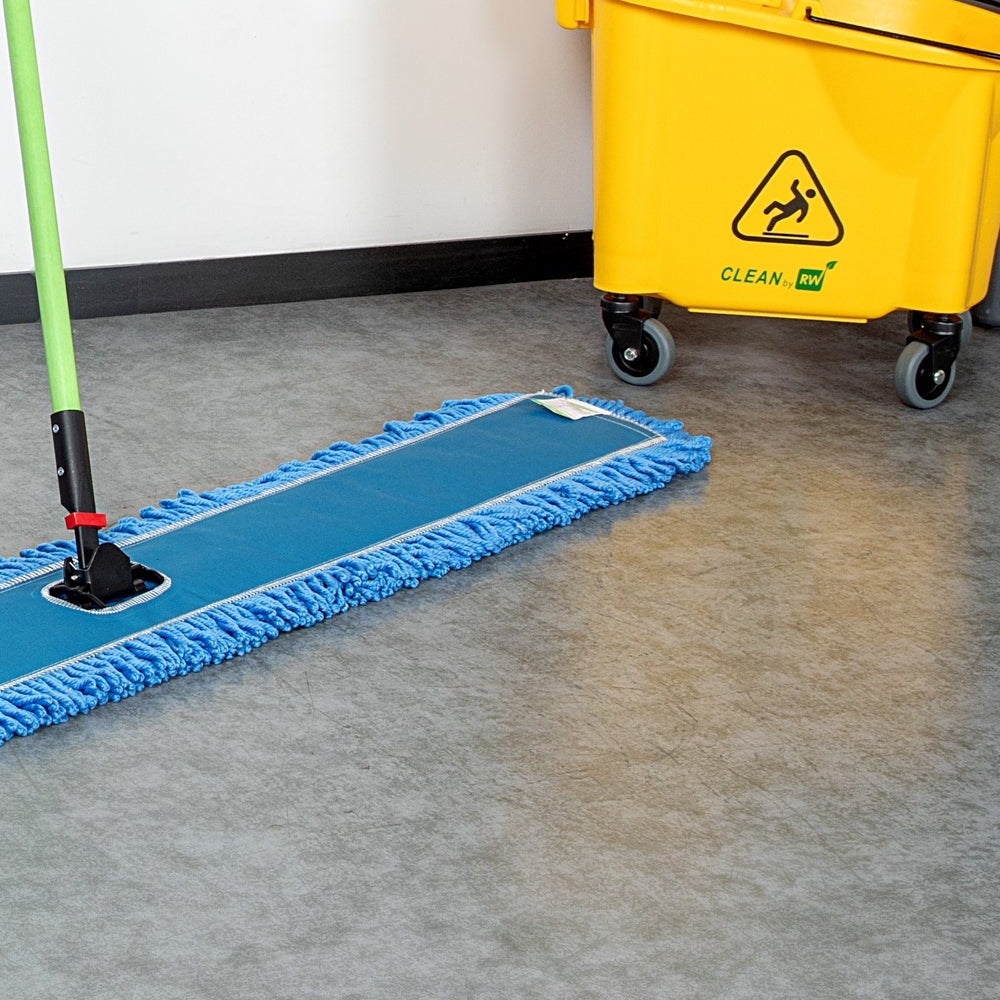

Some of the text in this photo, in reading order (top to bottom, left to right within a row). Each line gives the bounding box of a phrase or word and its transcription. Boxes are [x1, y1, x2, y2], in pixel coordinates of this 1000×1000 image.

[720, 266, 823, 290] CLEAN by RW
